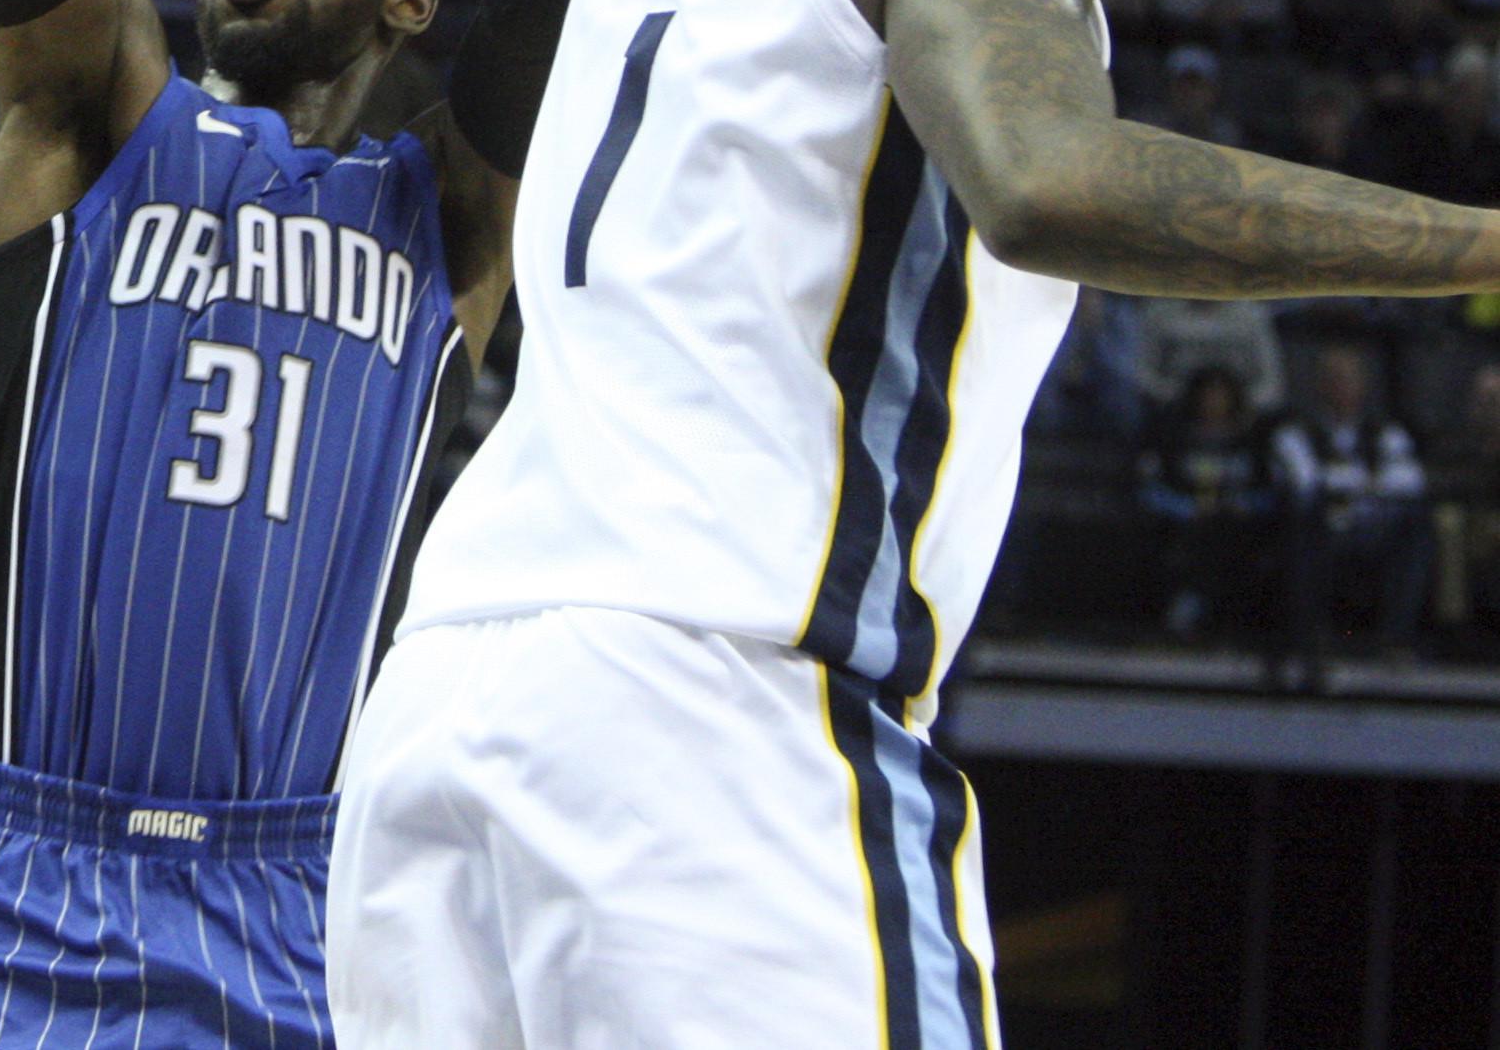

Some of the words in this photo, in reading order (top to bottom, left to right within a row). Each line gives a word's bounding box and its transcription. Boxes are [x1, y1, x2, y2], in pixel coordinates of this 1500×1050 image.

[564, 10, 677, 289] 1
[108, 203, 414, 366] ORLANDO
[167, 340, 313, 523] 31
[127, 809, 209, 843] MAGIC
